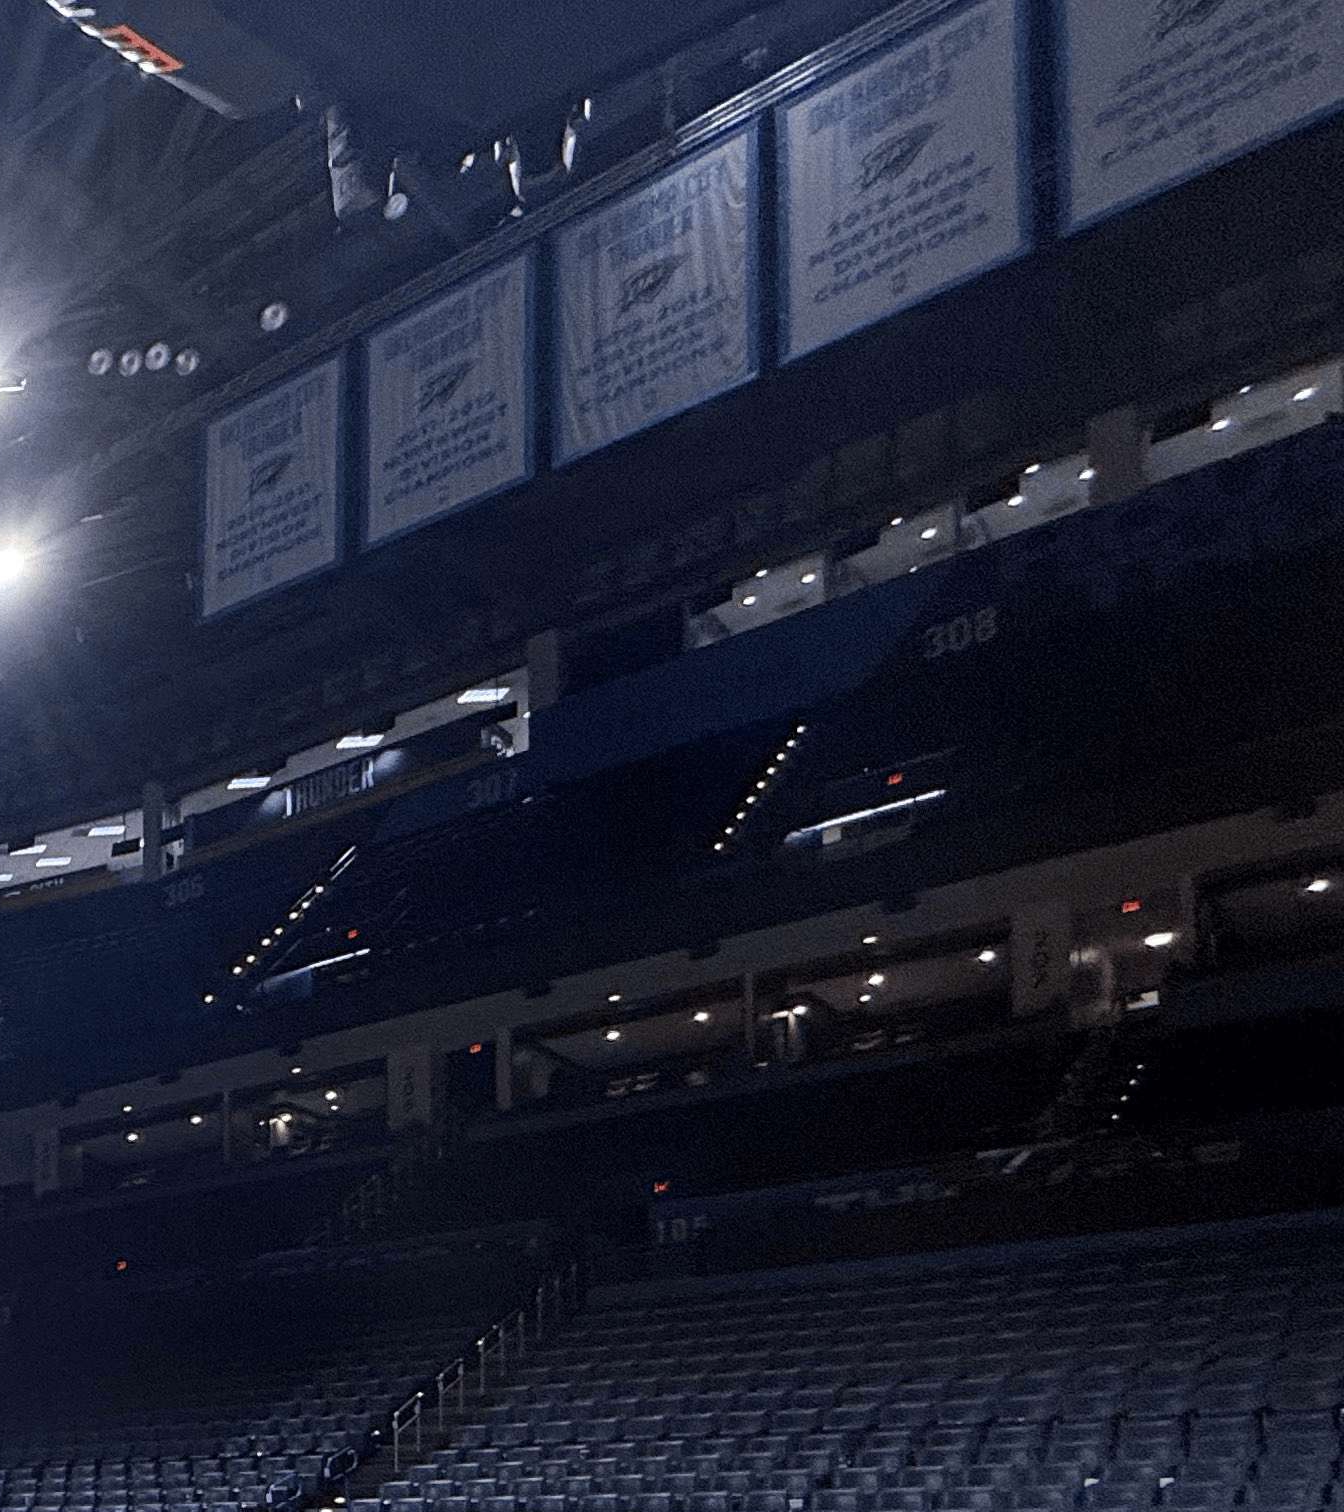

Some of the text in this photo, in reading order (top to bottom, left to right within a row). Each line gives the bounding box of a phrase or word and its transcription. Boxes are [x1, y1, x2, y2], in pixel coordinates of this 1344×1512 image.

[809, 164, 992, 269] NORTHWEST
[814, 208, 988, 306] CHAMPIONS
[834, 198, 965, 277] DIVISION
